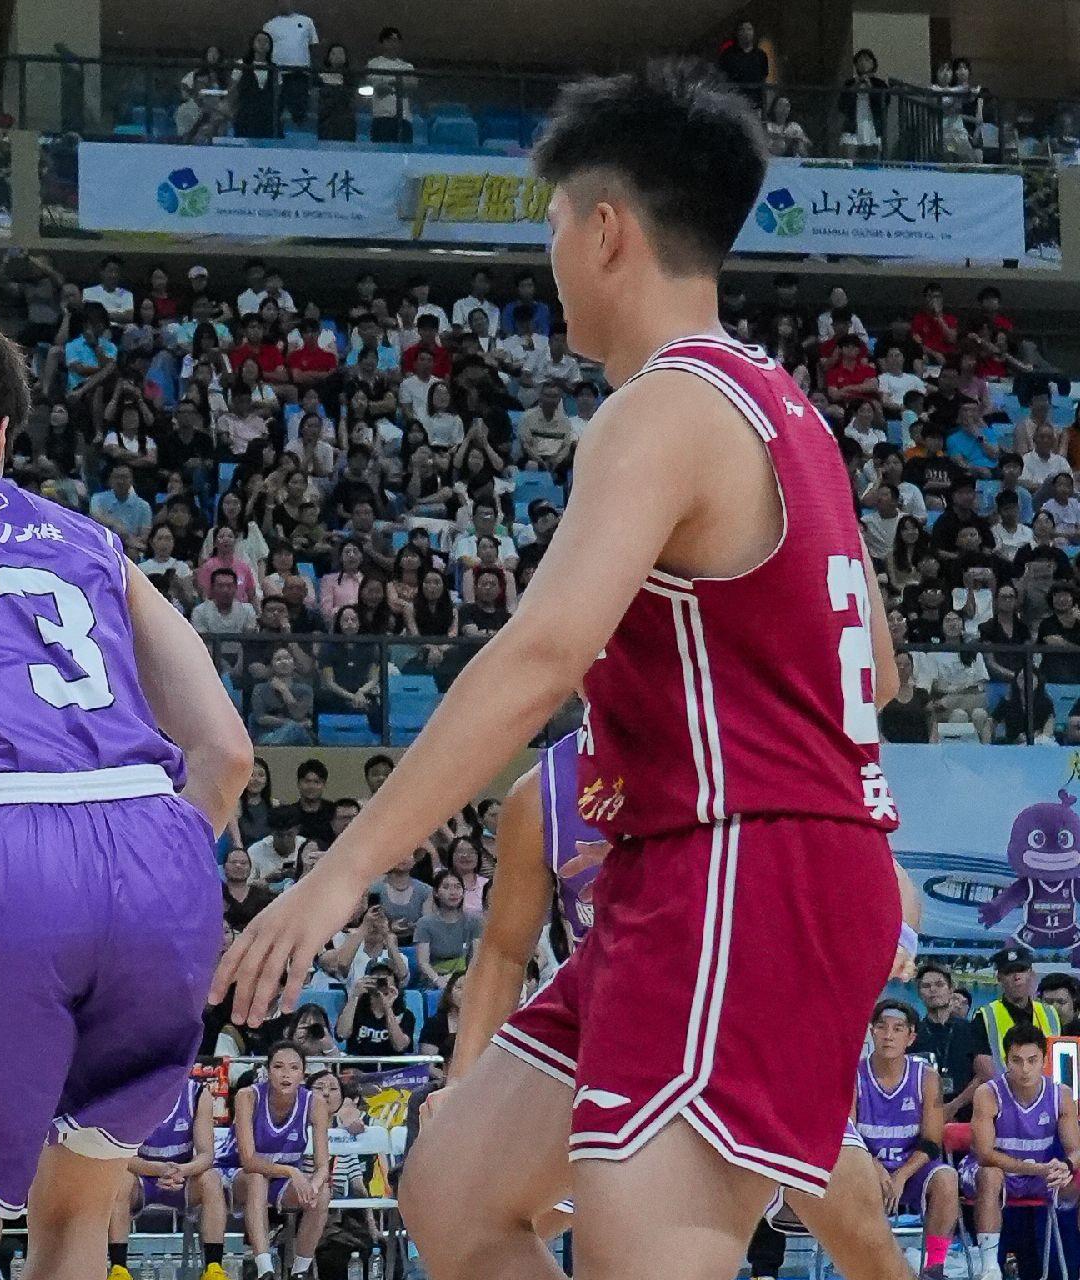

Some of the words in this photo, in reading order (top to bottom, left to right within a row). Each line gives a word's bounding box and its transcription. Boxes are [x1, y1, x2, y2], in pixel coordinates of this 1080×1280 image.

[215, 167, 365, 204] 山海文体
[811, 187, 953, 222] 山海文体
[860, 762, 898, 821] 英
